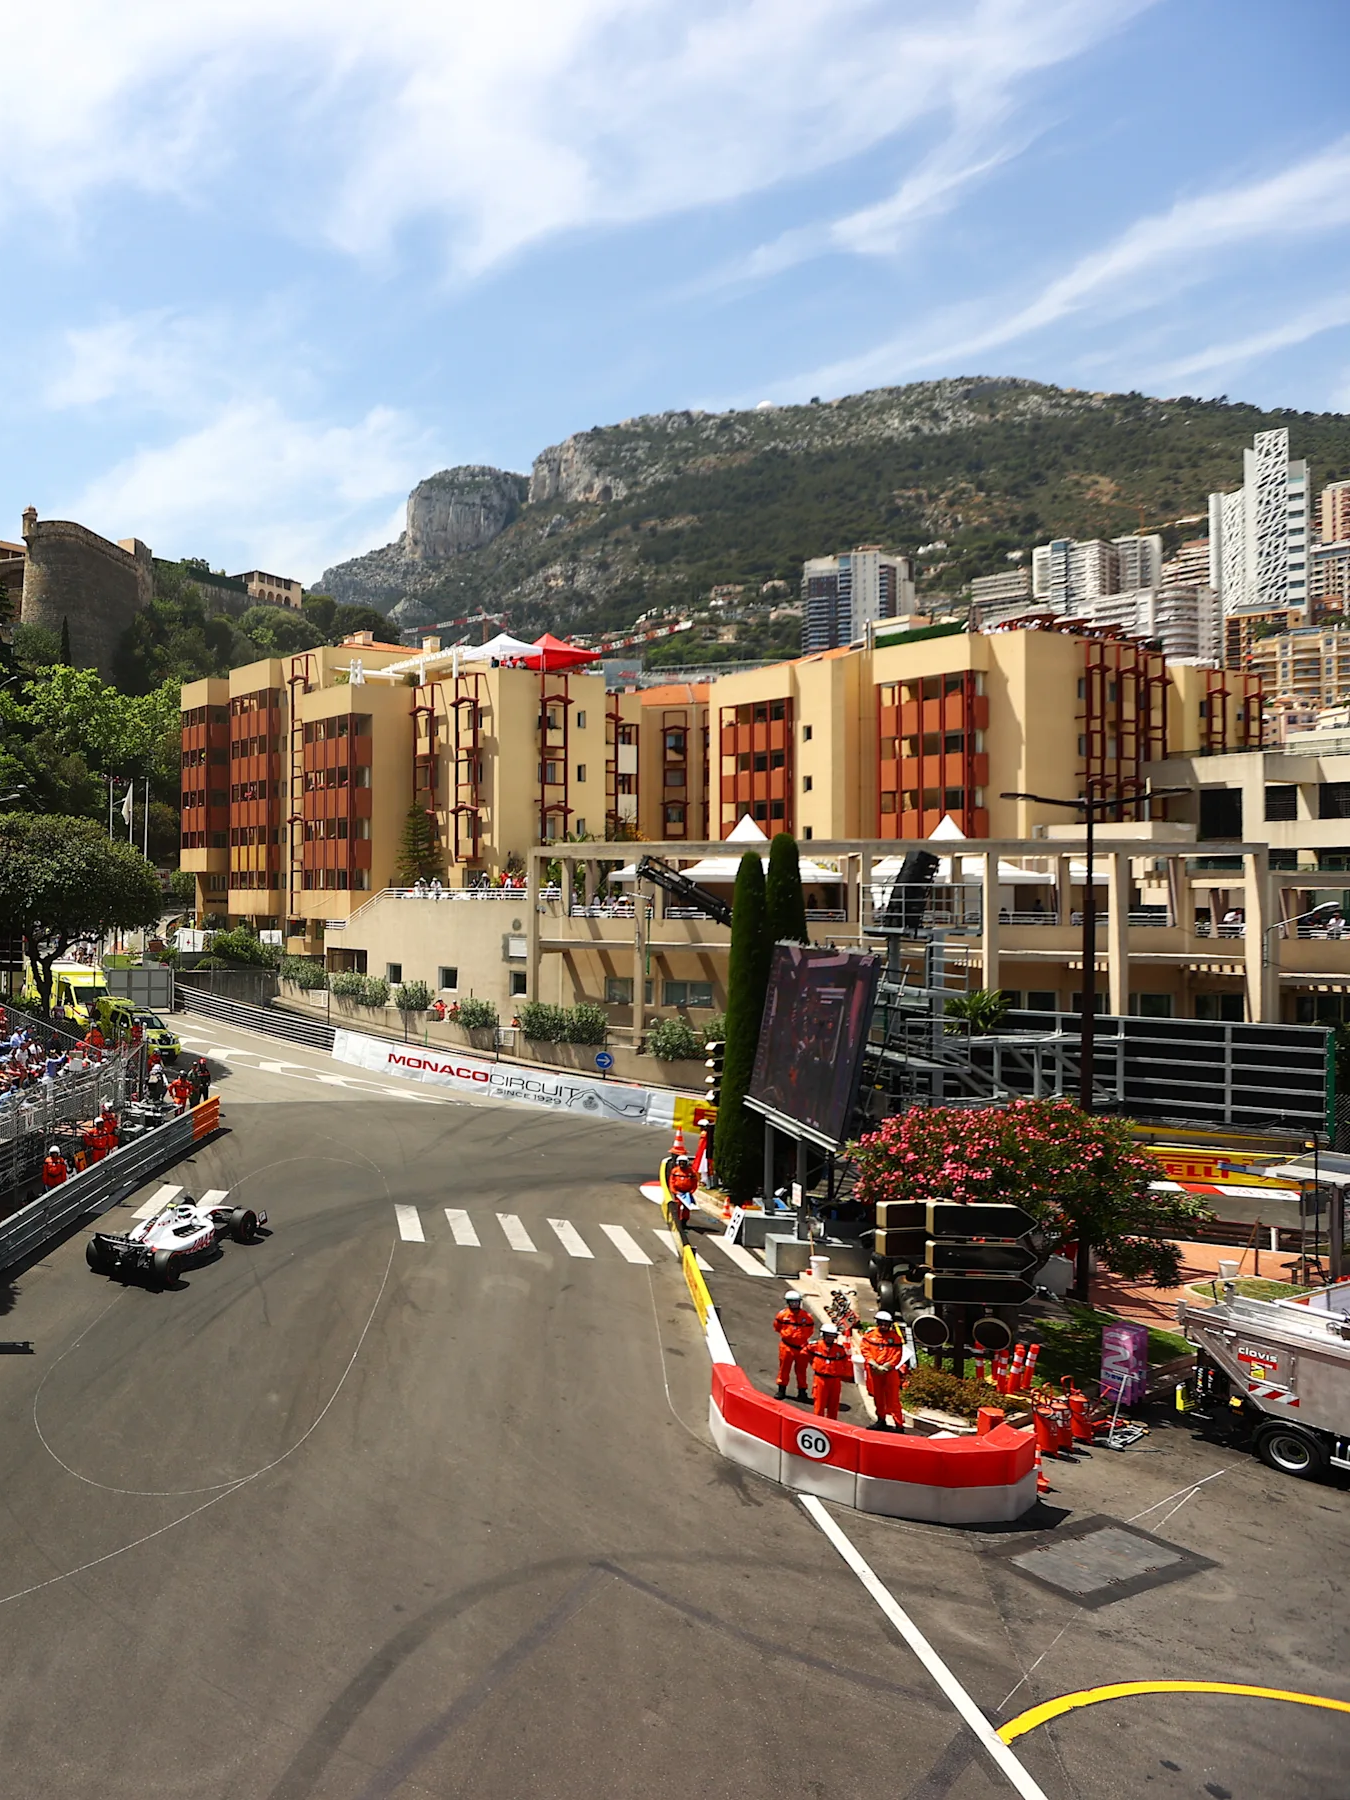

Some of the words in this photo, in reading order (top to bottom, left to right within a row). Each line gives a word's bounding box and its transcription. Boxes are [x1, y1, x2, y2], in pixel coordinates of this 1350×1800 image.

[496, 1087, 530, 1101] SINCE
[533, 1093, 562, 1105] 1929
[1238, 1346, 1278, 1363] clovis
[801, 1433, 826, 1453] 60
